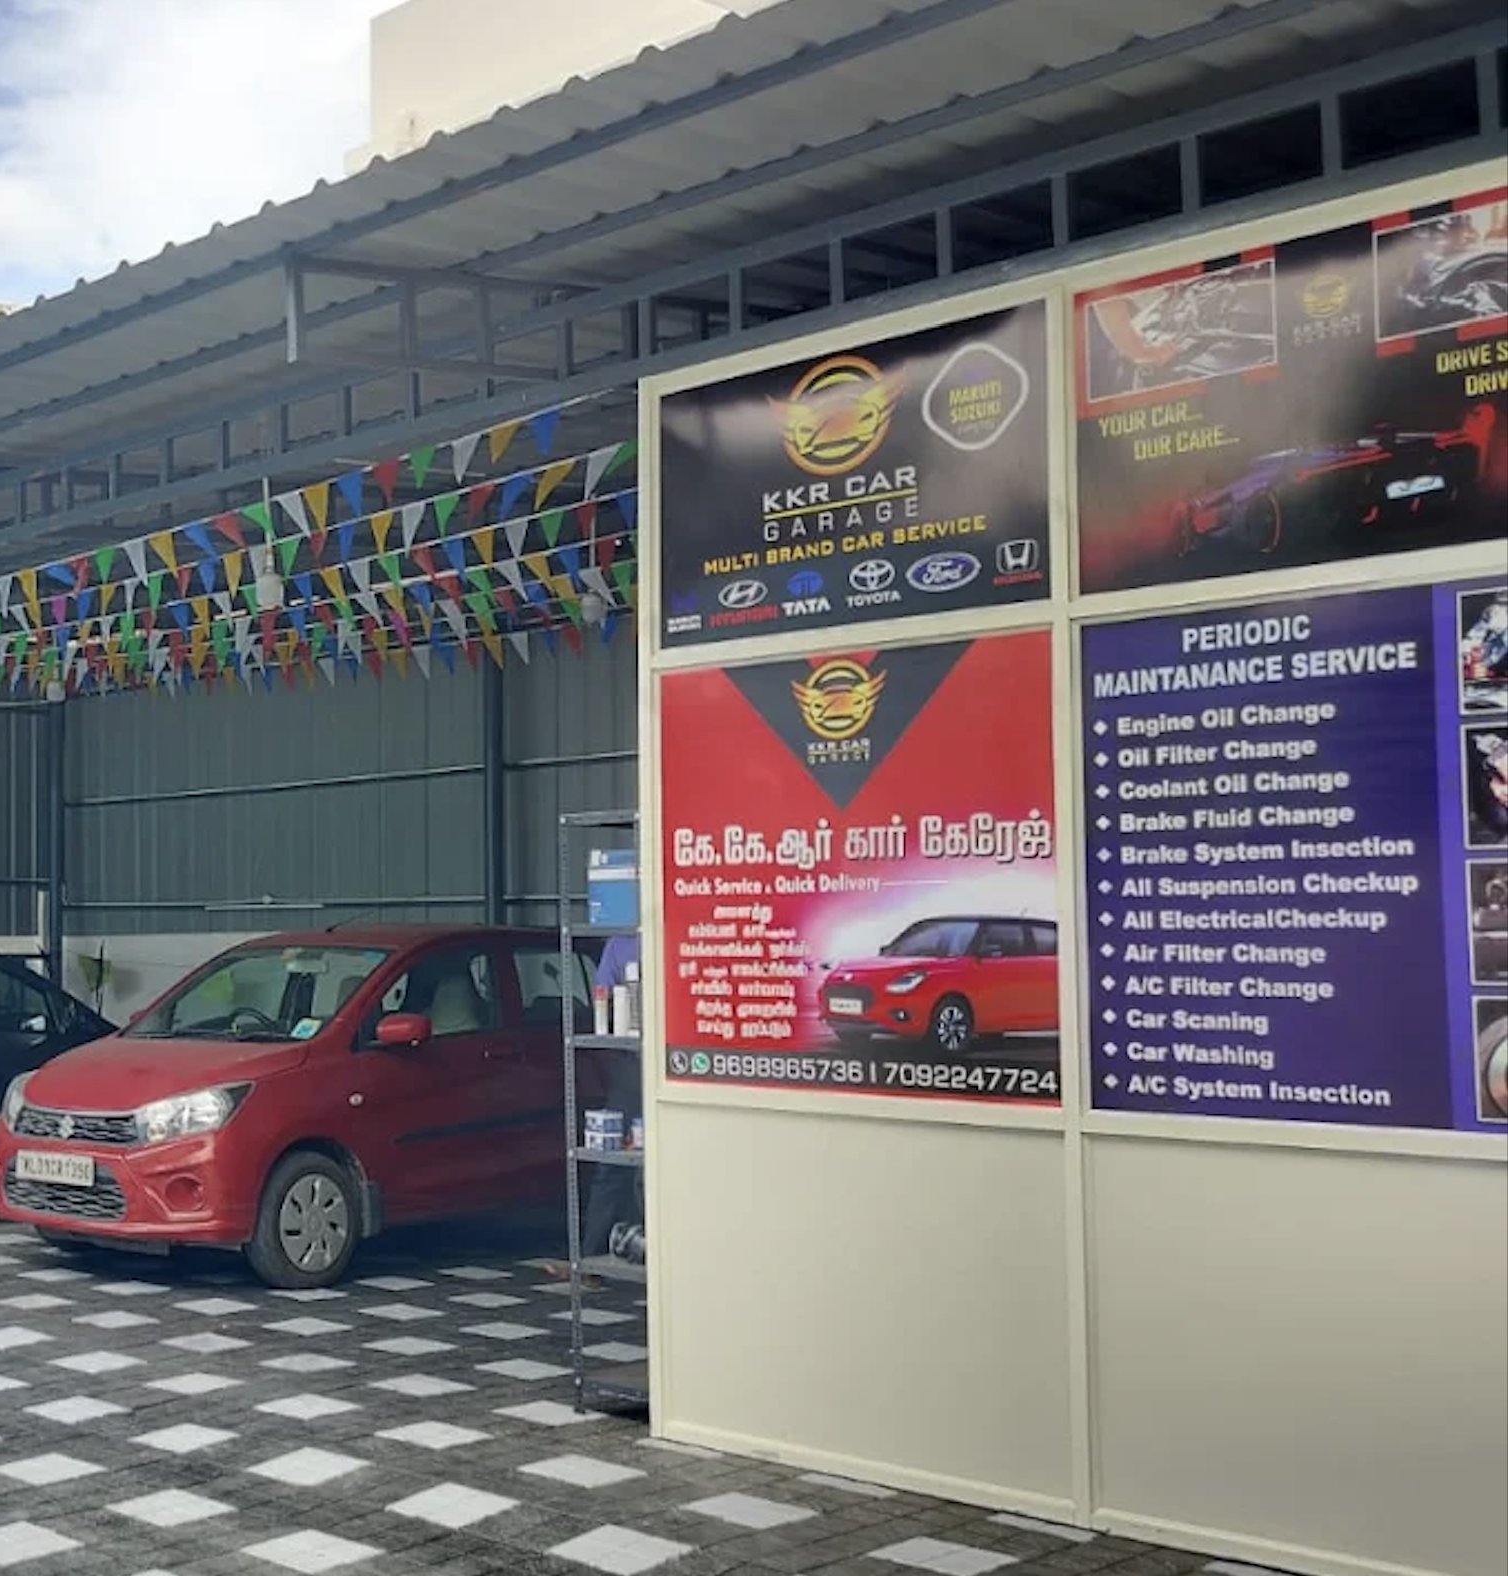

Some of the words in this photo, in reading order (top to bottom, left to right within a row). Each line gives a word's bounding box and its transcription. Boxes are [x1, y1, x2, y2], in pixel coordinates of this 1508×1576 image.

[1436, 343, 1492, 374] DRIVE
[949, 379, 1002, 406] MARUTI
[949, 400, 1002, 425] SUZUKI
[1098, 412, 1146, 438] YOUR
[1134, 437, 1177, 461] OUR
[762, 482, 829, 513] KKR
[845, 466, 918, 495] CAR
[763, 496, 920, 543] GARAGE
[704, 553, 758, 576] MULTI
[766, 542, 833, 565] BRAND
[842, 533, 884, 553] CAR
[892, 515, 987, 546] SERVICE
[922, 560, 963, 585] Ford
[781, 597, 831, 617] TATA
[845, 590, 902, 608] TOYOTA
[1182, 615, 1310, 653] PERIODIC
[1094, 654, 1282, 698] MAINTANANCE
[1291, 642, 1417, 678] SERVICE
[1117, 714, 1194, 738] Engine
[1202, 707, 1233, 729] Oil
[1241, 701, 1336, 727] Change
[1118, 747, 1149, 768] Oil
[1156, 743, 1217, 765] Filter
[1223, 737, 1318, 762] Change
[1118, 778, 1207, 799] Coolant
[1214, 774, 1246, 795] Oil
[1254, 769, 1350, 794] Change
[1119, 811, 1187, 833] Brake
[1193, 808, 1251, 829] Fluid
[1259, 803, 1354, 828] Change
[673, 818, 833, 870] கே.கே.ஆர்
[845, 815, 907, 861] கார்
[919, 808, 1053, 863] கேரேஜ்
[1120, 845, 1188, 866] Brake
[1194, 841, 1284, 866] System
[1292, 836, 1415, 859] Insection
[674, 878, 712, 896] Quick
[714, 876, 762, 895] Service
[775, 874, 815, 893] Quick
[819, 872, 881, 893] Delivery
[1122, 878, 1151, 897] All
[1158, 875, 1295, 899] Suspension
[1303, 872, 1420, 895] Checkup
[1123, 911, 1153, 930] All
[1124, 943, 1157, 963] Air
[1163, 943, 1226, 963] Filter
[1232, 944, 1326, 968] Change
[1125, 976, 1164, 997] A/C
[1170, 976, 1233, 997] Filter
[1239, 977, 1334, 1002] Change
[1126, 1008, 1166, 1029] Car
[1173, 1010, 1269, 1035] Scaning
[1127, 1041, 1167, 1062] Car
[1173, 1043, 1274, 1069] Washing
[713, 1055, 863, 1083] 9698965736
[884, 1064, 1058, 1093] 7092247724
[1128, 1075, 1167, 1095] A/C
[1173, 1076, 1262, 1101] System
[1270, 1080, 1391, 1106] Insection
